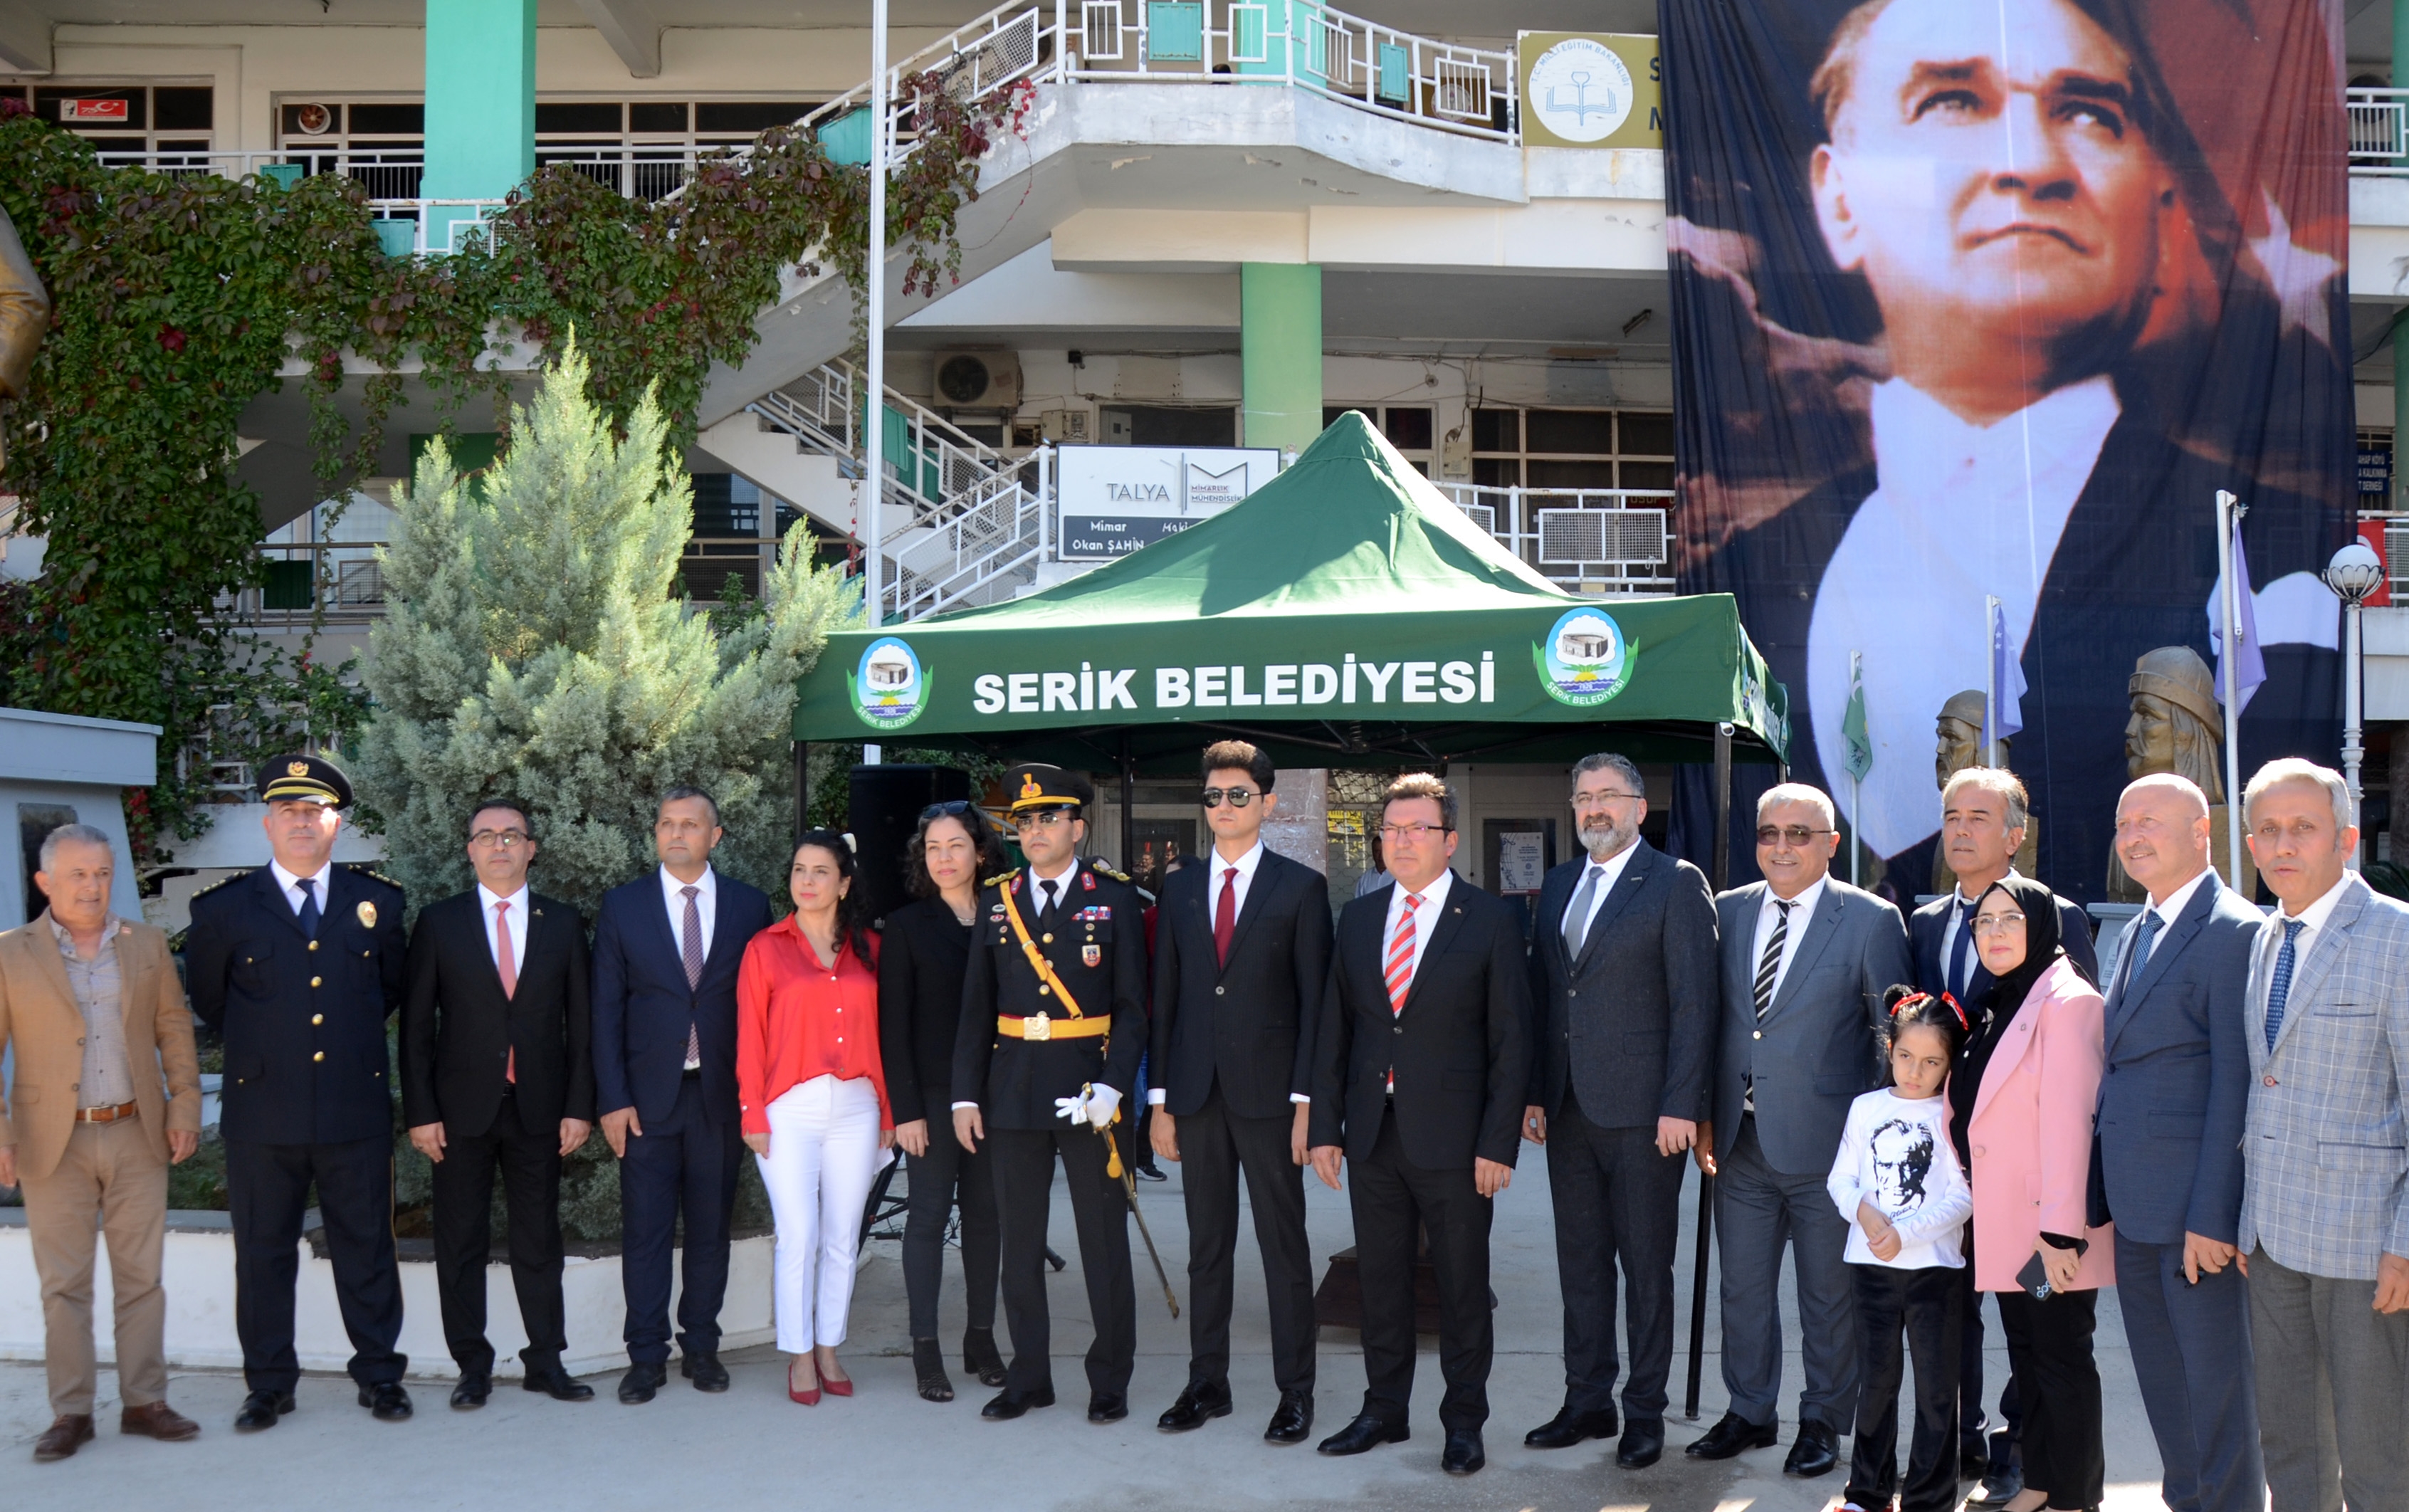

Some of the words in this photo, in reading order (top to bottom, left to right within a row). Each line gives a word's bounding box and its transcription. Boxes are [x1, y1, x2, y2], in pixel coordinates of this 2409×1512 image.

[1562, 41, 1592, 52] EĞİTİM
[1595, 46, 1630, 86] BAKANLIĞI
[1106, 483, 1170, 502] TALYA
[1191, 484, 1229, 493] MİMARLIK
[1191, 493, 1243, 503] MÜHENDİSLİK
[1091, 520, 1127, 532] Mimar
[1072, 539, 1103, 551] Okan
[1108, 537, 1145, 554] ŞAHİN
[973, 661, 1137, 714] SERİK
[1155, 651, 1496, 708] BELEDİYESİ
[1546, 681, 1571, 702] SERİK
[1573, 678, 1625, 704] BELEDİYESİ
[858, 705, 878, 725] SERİK
[879, 704, 923, 728] BELEDİYESİ
